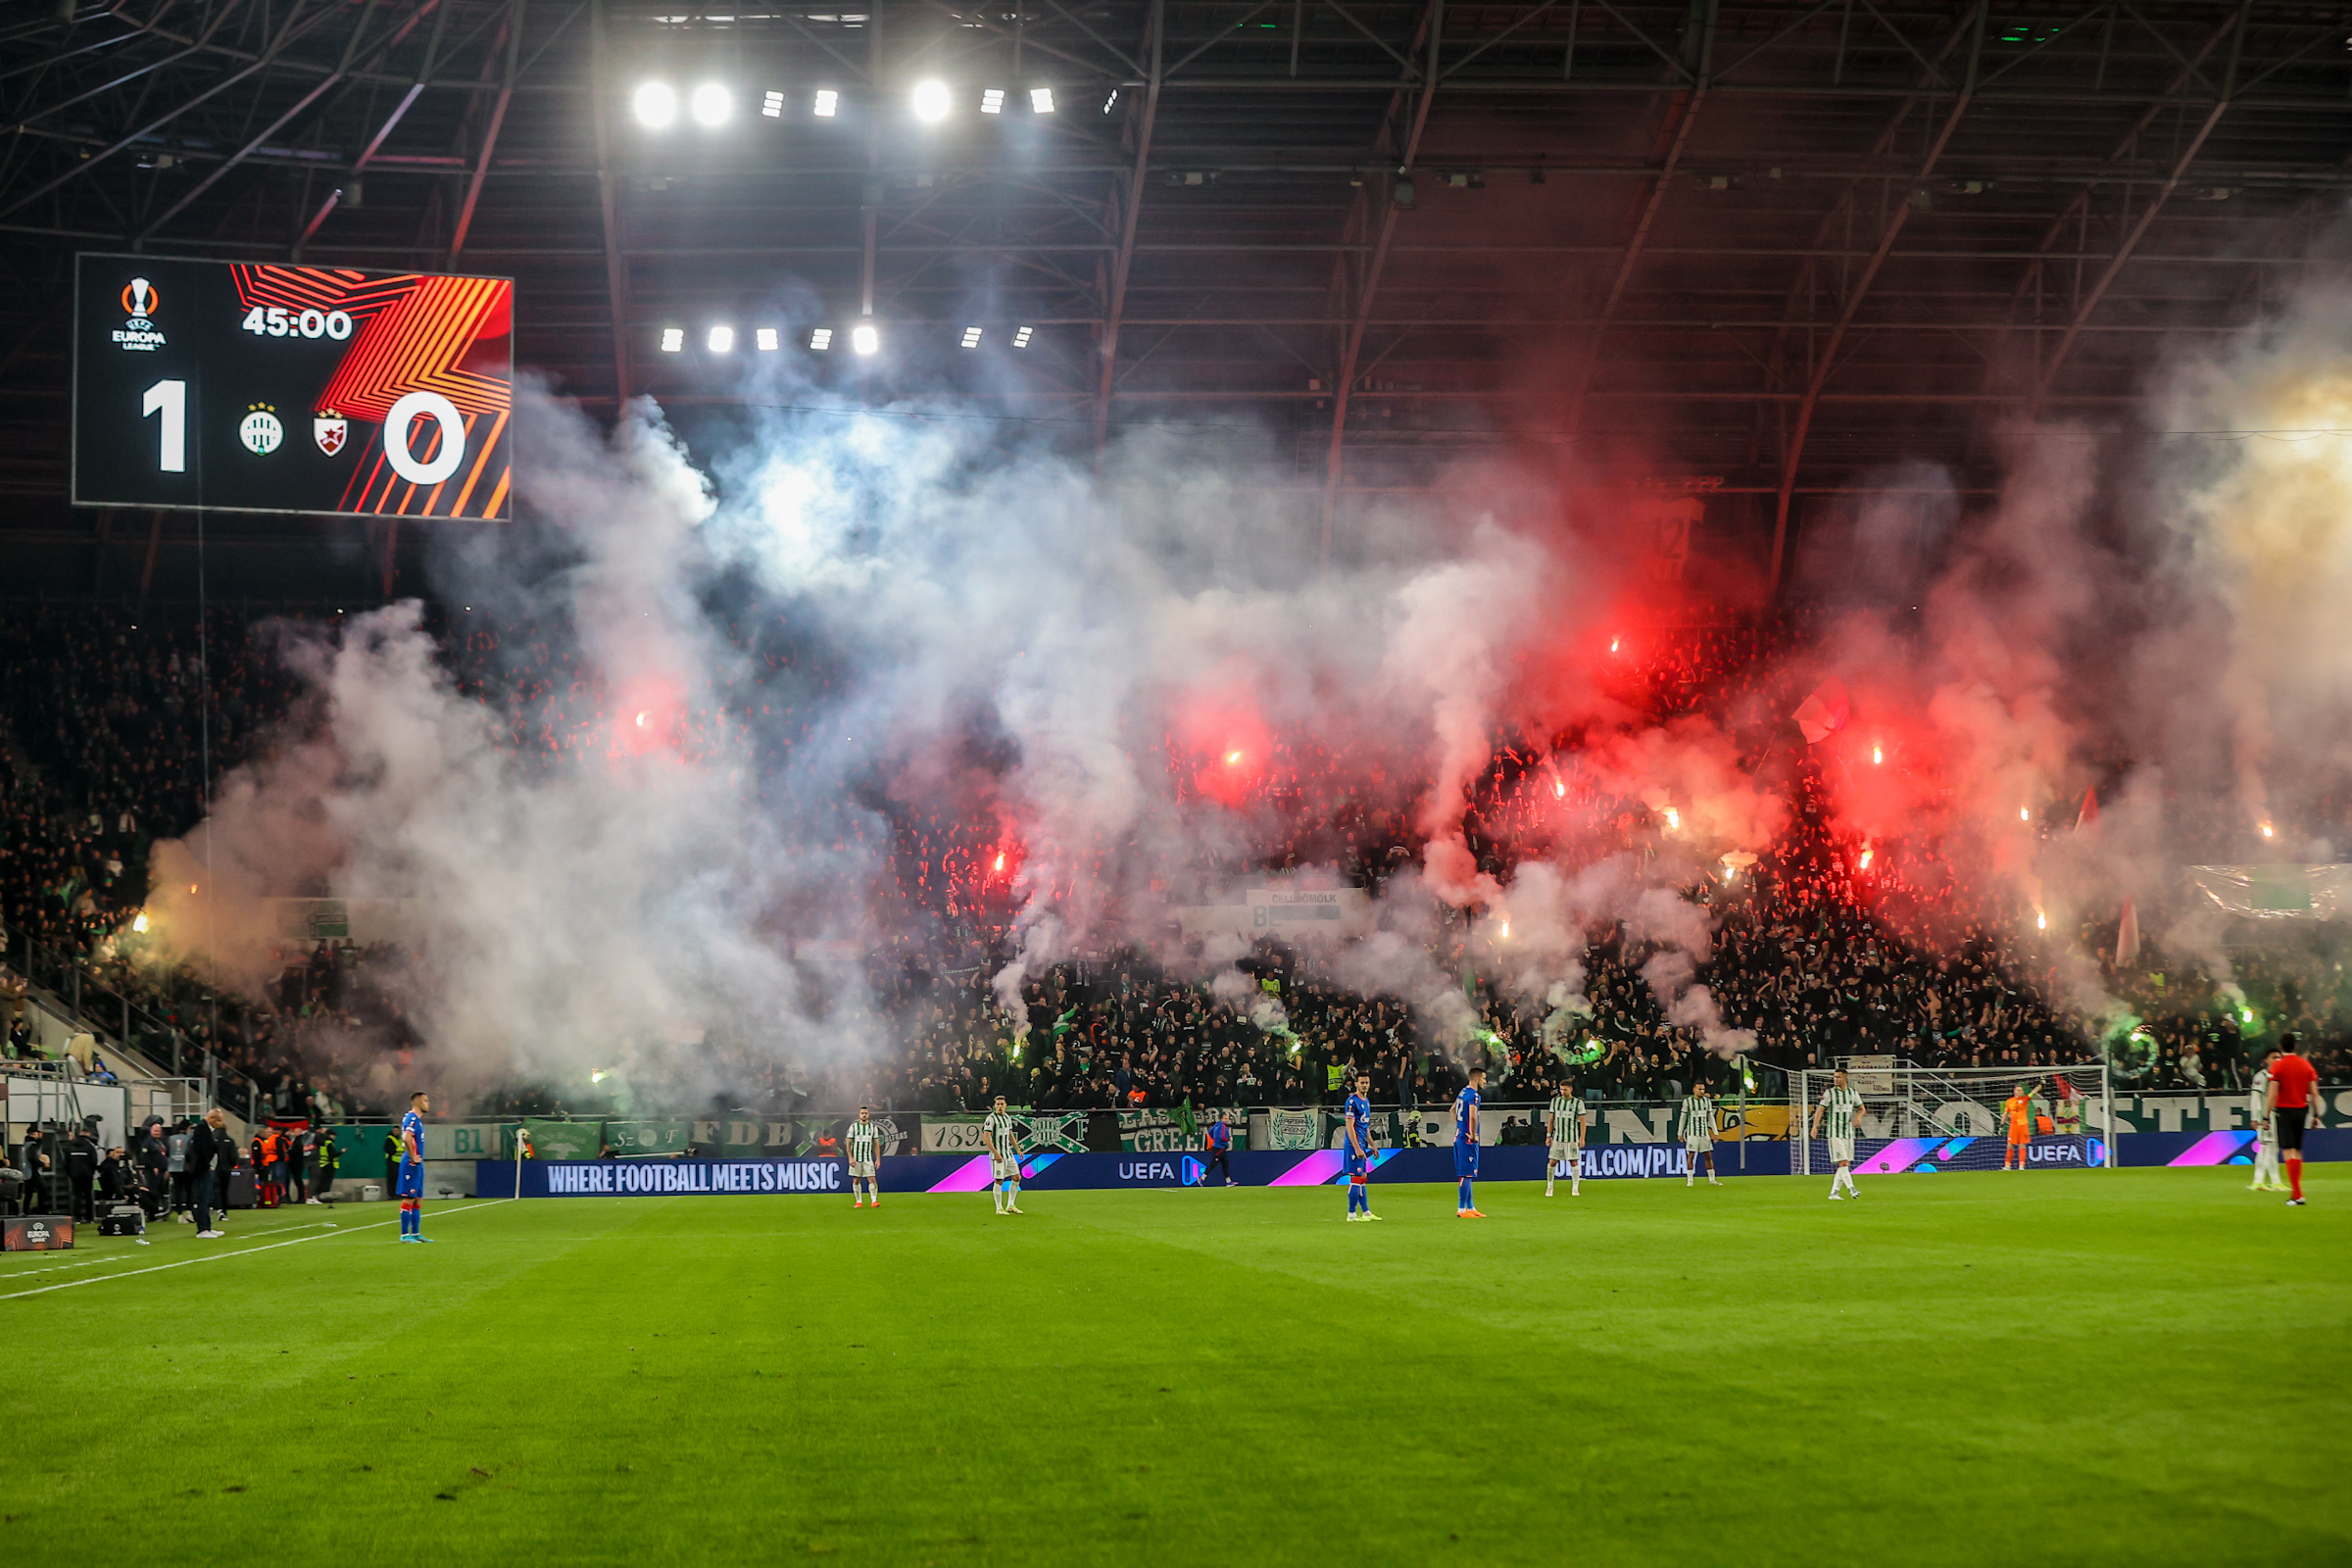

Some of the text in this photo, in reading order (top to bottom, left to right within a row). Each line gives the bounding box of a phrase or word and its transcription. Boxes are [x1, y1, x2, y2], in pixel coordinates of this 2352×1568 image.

[242, 307, 353, 341] 45:00
[112, 329, 167, 344] EUROPA
[142, 379, 186, 472] 1
[383, 391, 466, 485] 0
[1119, 1106, 1244, 1129] EASERN
[455, 1129, 484, 1153] B1
[1076, 1119, 1090, 1142] F
[2028, 1145, 2082, 1162] UEFA
[548, 1162, 840, 1193] WHERE FOOTBALL MEETS MUSIC
[1119, 1162, 1175, 1179] UEFA
